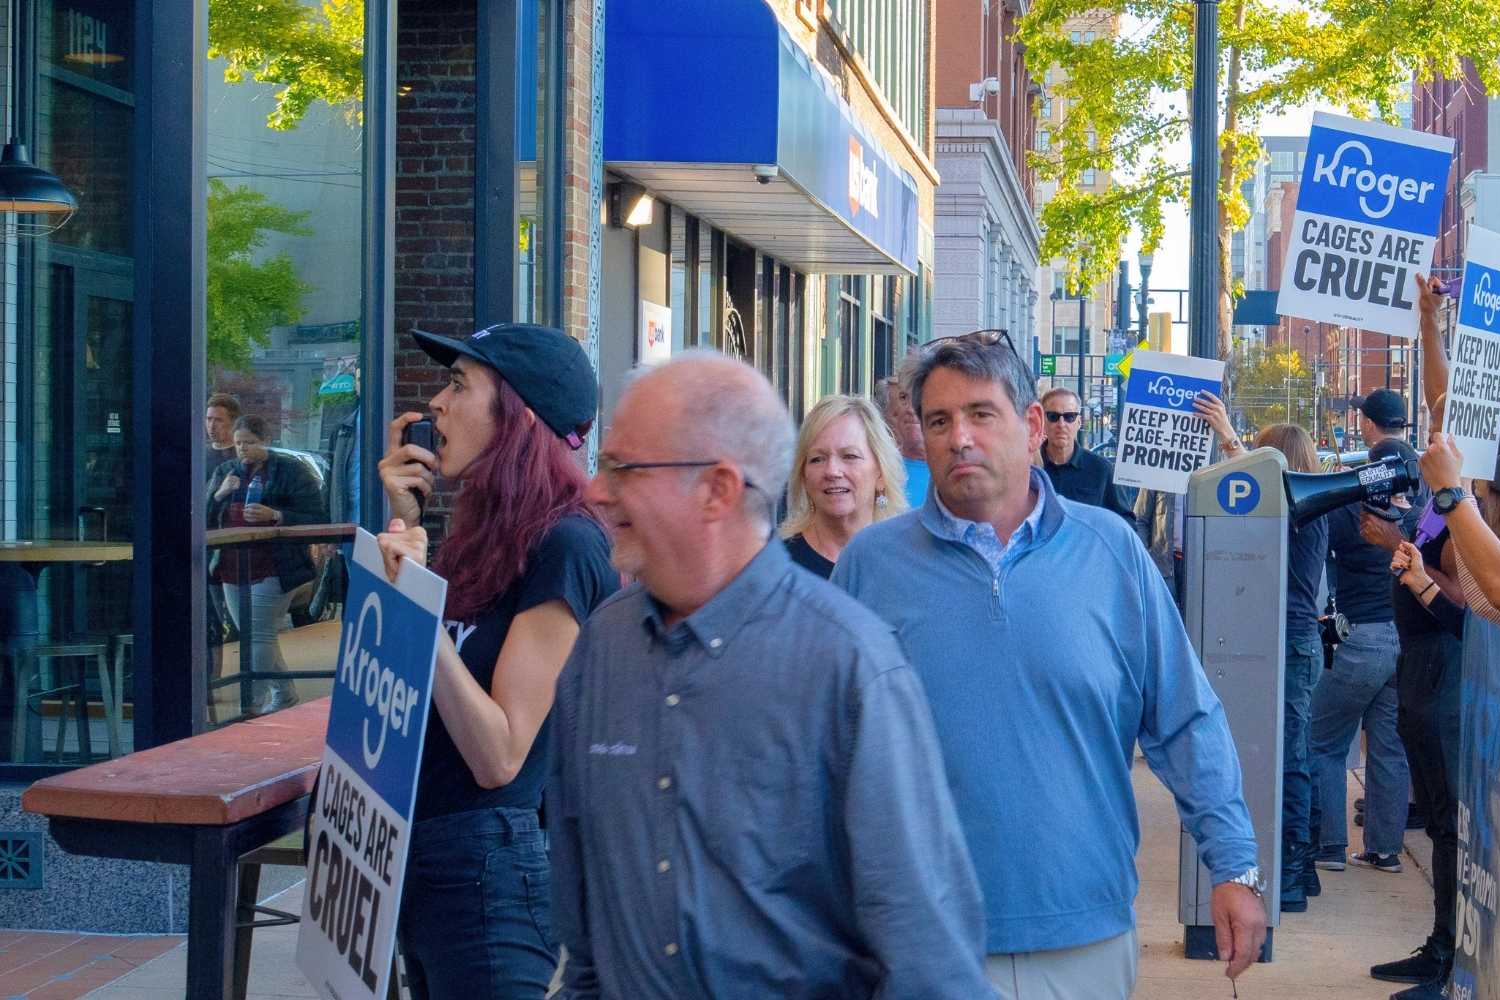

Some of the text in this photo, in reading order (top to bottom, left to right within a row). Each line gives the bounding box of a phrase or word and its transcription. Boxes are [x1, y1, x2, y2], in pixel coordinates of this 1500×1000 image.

[1313, 140, 1435, 219] Kroger
[1301, 218, 1424, 265] CAGES ARE
[1293, 248, 1413, 310] CRUEL
[1456, 333, 1483, 366] KEEP
[1148, 376, 1201, 407] Kroger
[1125, 426, 1209, 453] CAGE-FREE
[1127, 408, 1211, 436] KEEP YOUR
[1447, 400, 1500, 441] PROMISE
[1229, 480, 1251, 507] P
[341, 591, 419, 769] Kroger
[321, 764, 399, 887] CAGES ARE
[309, 829, 382, 995] CRUEL
